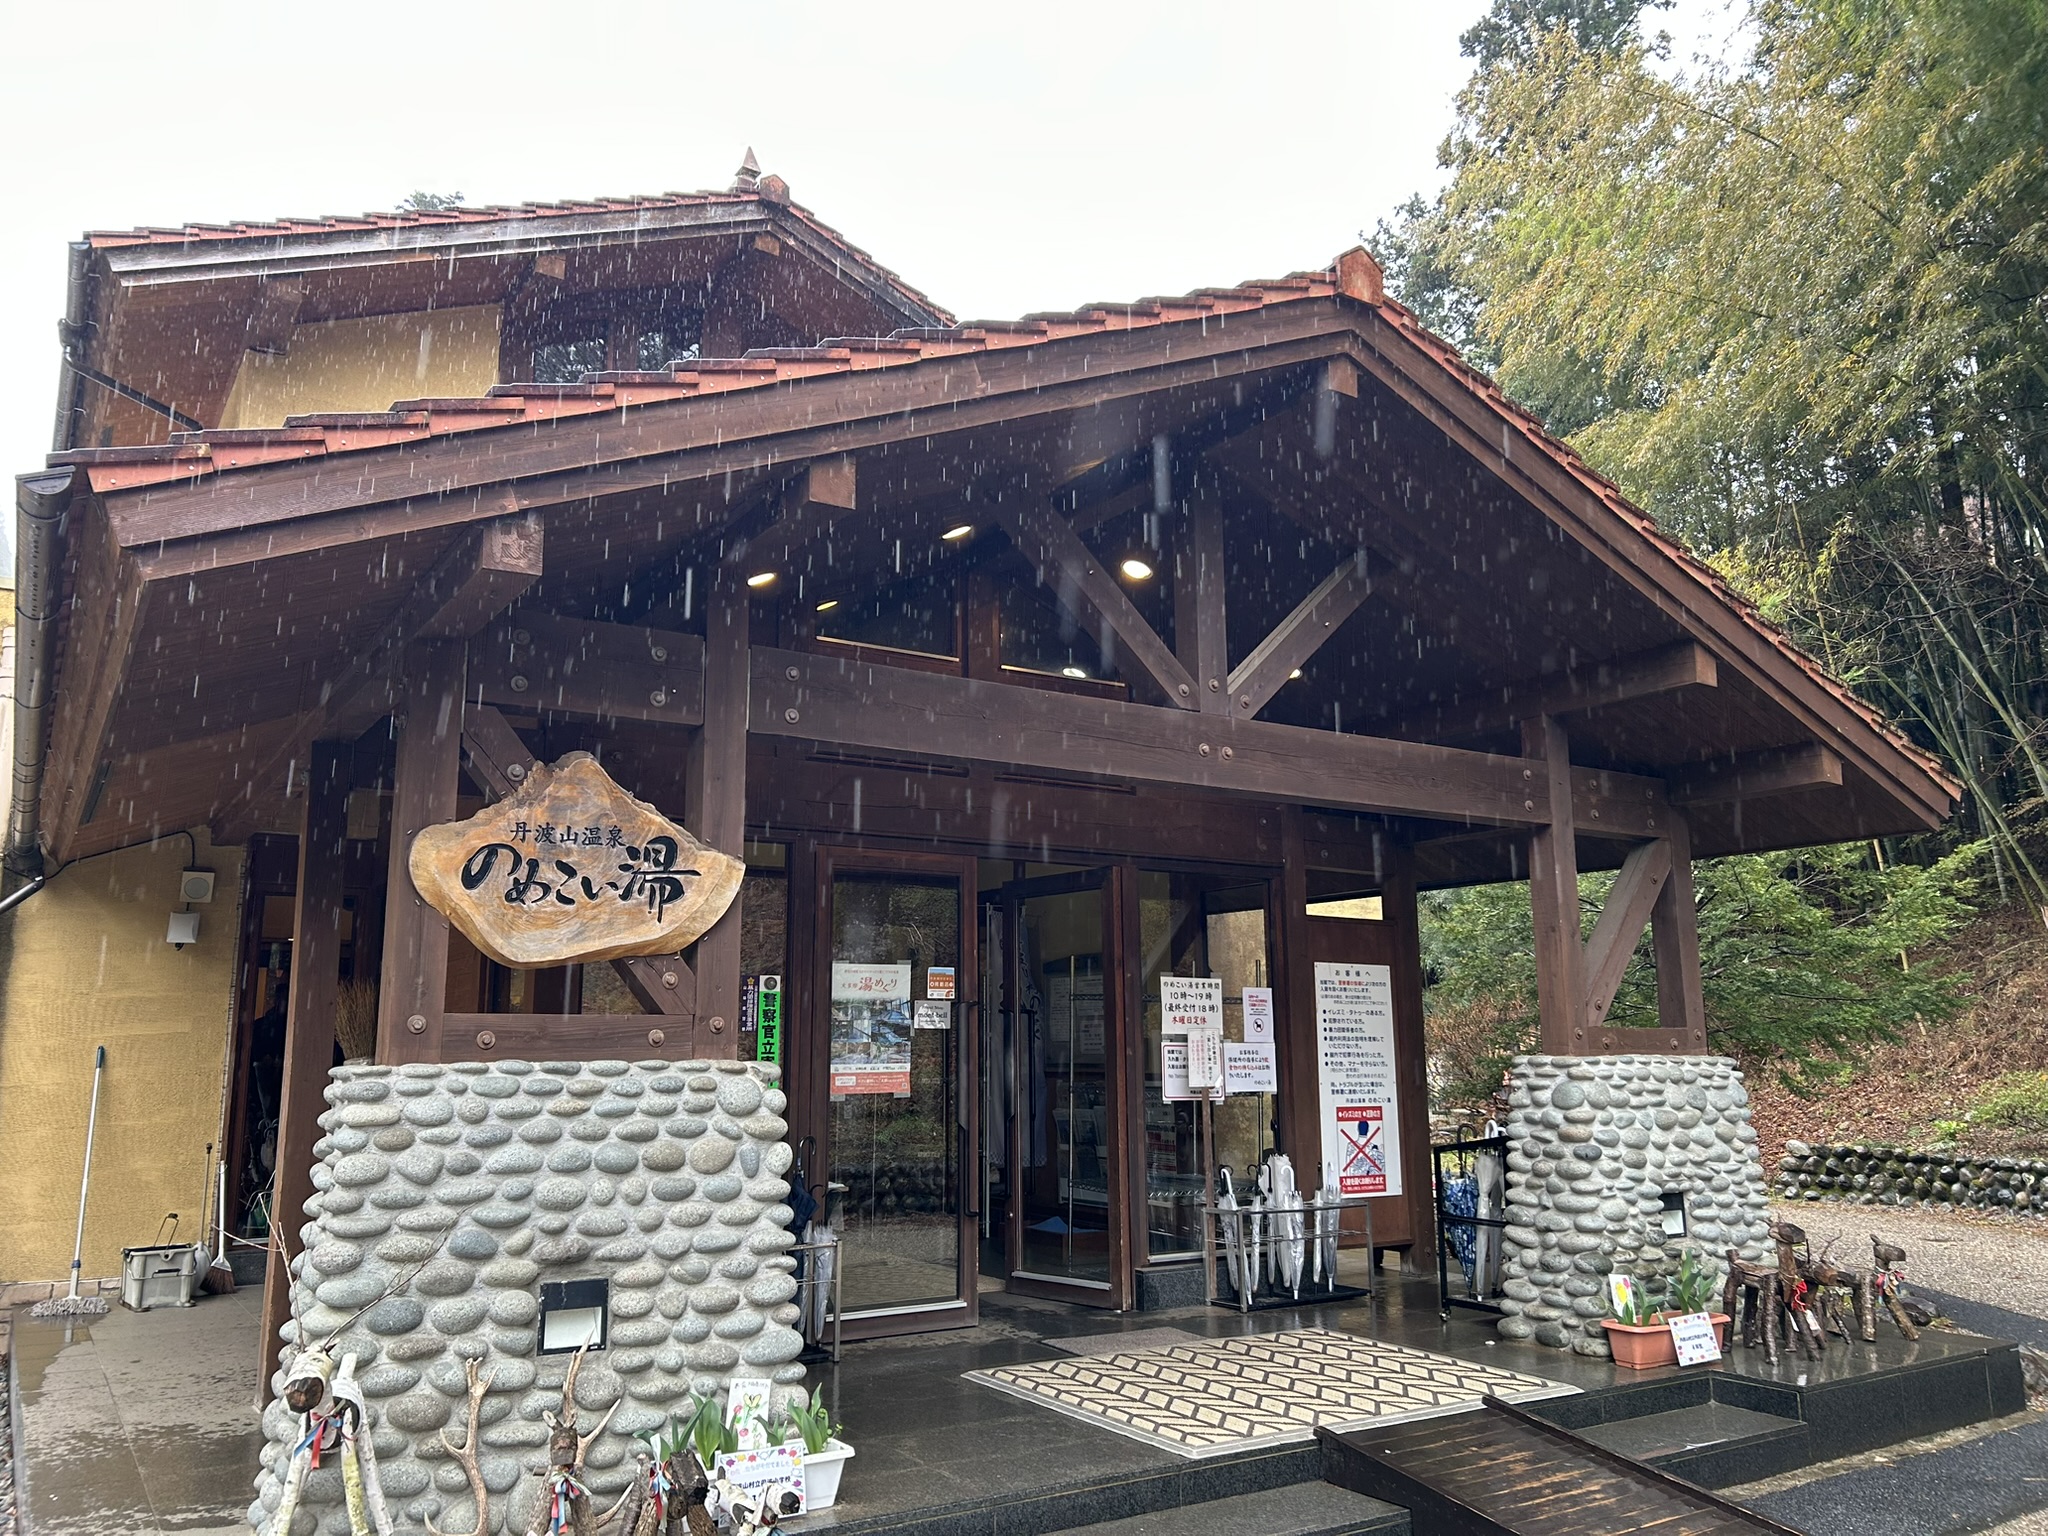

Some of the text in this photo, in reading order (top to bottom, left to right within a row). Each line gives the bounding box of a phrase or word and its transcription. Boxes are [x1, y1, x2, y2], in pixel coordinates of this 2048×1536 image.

[510, 822, 626, 848] 丹波山温泉
[461, 835, 701, 923] のめこい湯
[1163, 981, 1220, 990] のめこい湯営業時間
